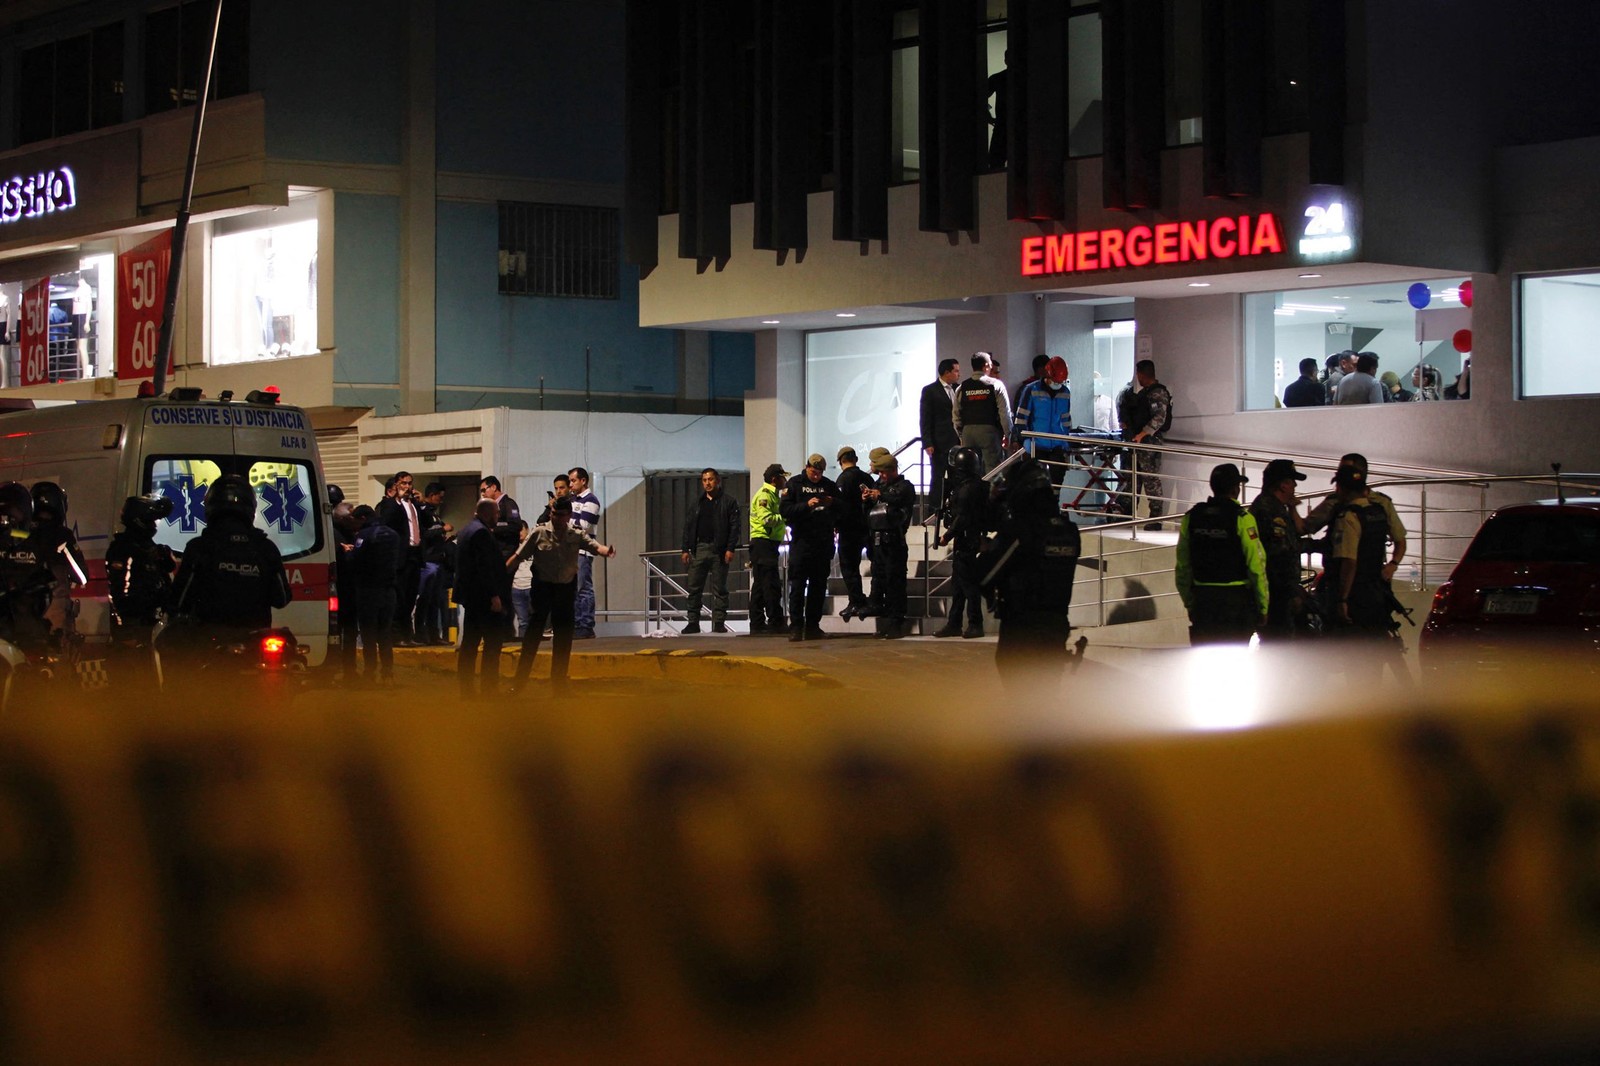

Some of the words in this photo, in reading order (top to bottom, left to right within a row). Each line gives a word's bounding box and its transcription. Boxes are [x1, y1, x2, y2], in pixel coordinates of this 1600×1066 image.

[1304, 202, 1345, 235] 24
[1021, 212, 1283, 277] EMERGENCIA
[132, 259, 156, 310] 50
[27, 297, 44, 336] 50
[27, 344, 44, 382] 60
[132, 320, 156, 370] 60
[151, 408, 220, 425] CONSERVE
[224, 409, 242, 427] SU
[246, 410, 305, 430] DISTANCIA
[281, 436, 301, 449] ALFA
[302, 437, 306, 449] 8
[218, 562, 260, 574] POLICIA
